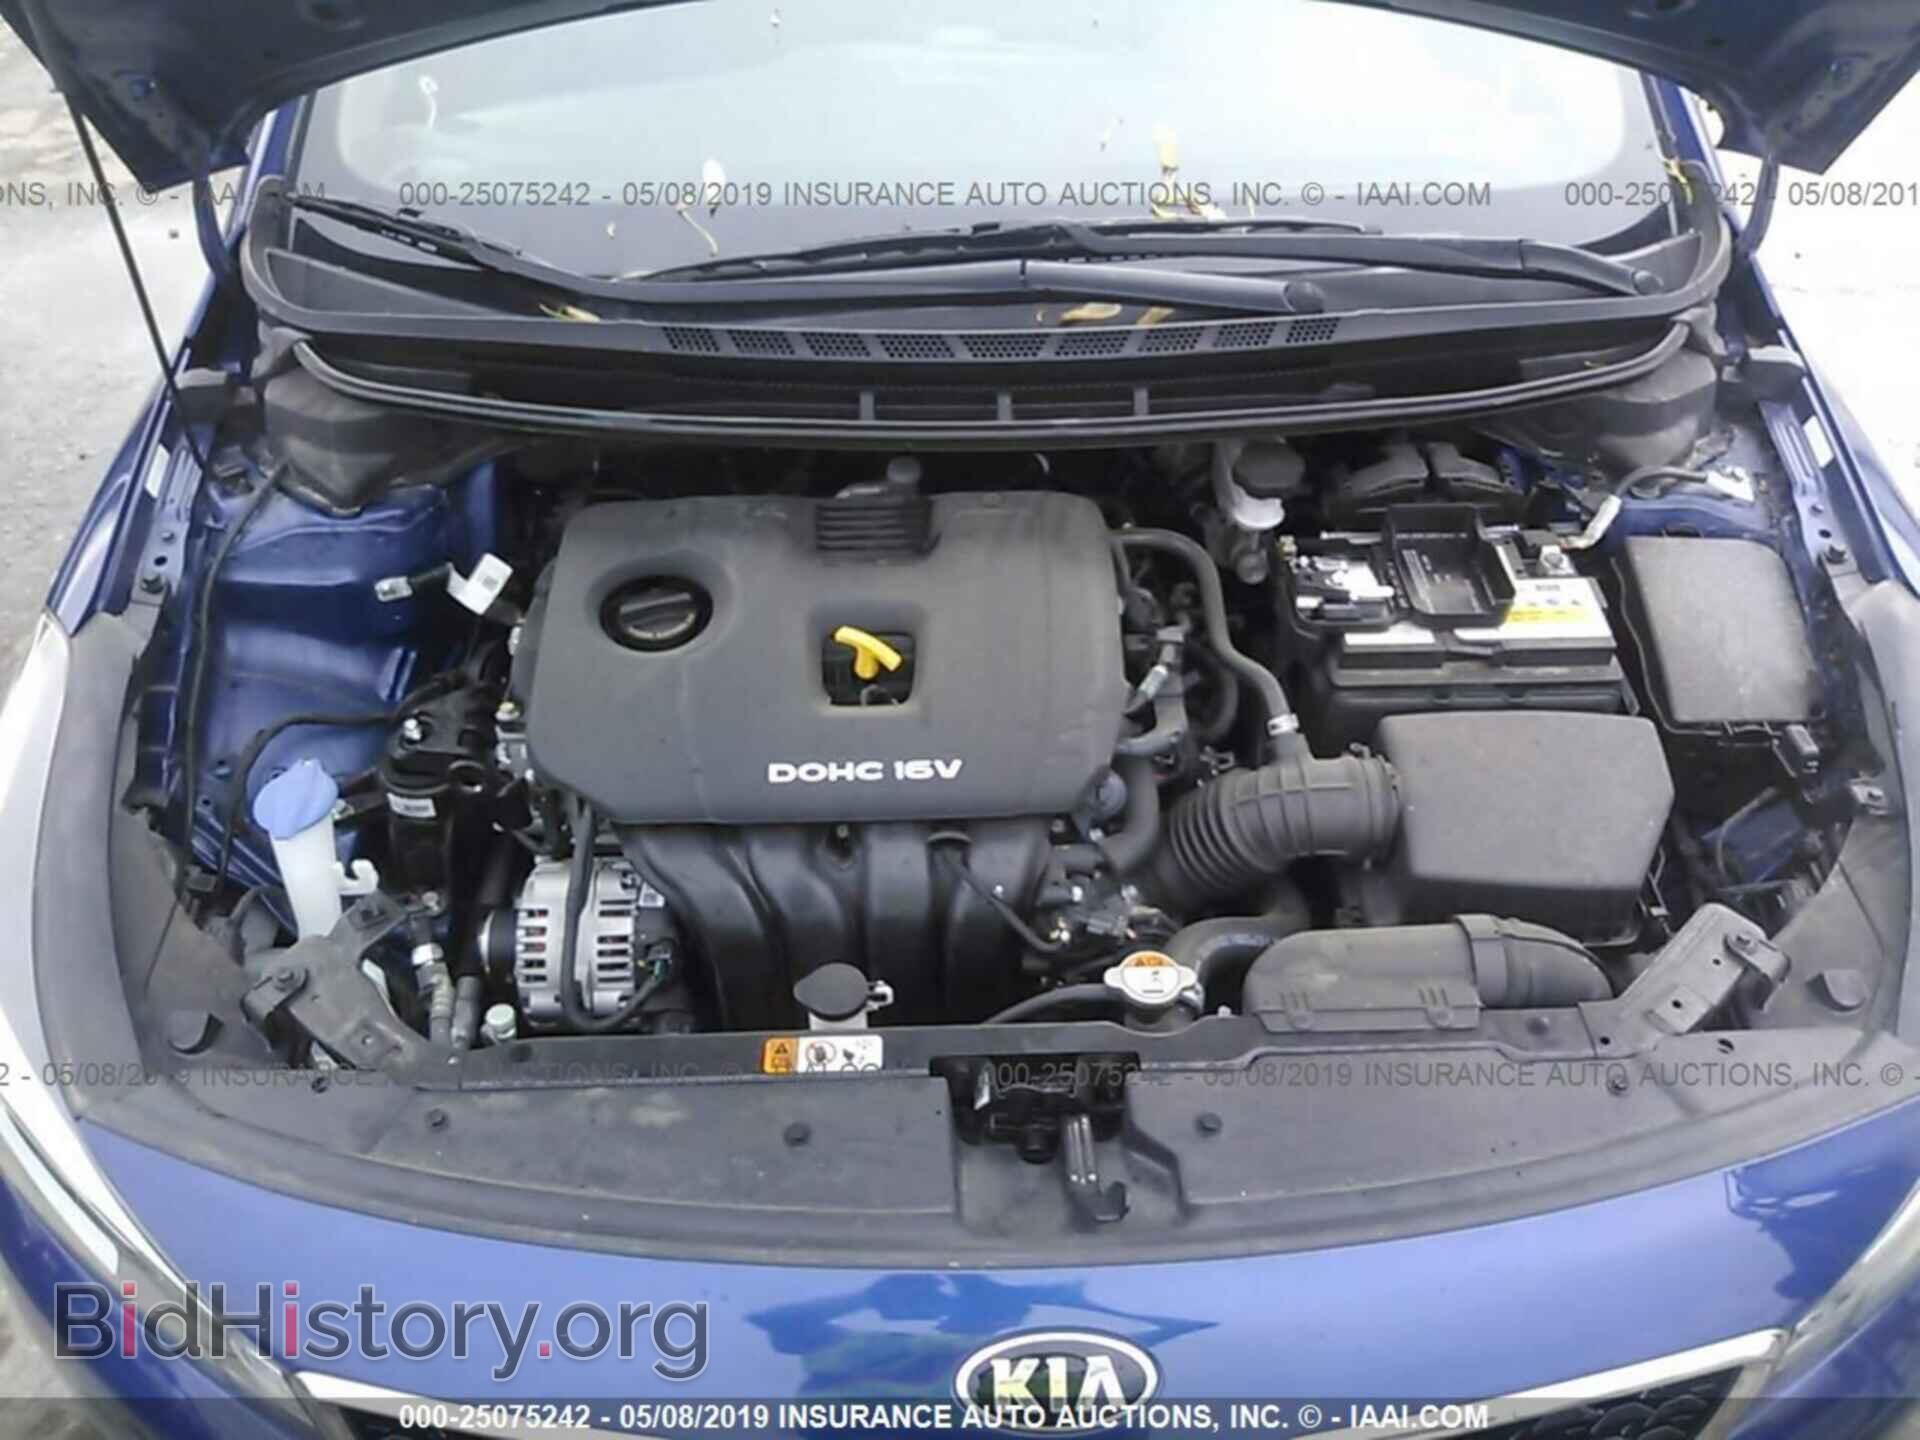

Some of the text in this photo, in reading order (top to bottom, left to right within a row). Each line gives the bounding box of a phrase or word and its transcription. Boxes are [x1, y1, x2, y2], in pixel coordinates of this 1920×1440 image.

[768, 758, 963, 784] DOHC 16V
[990, 1355, 1126, 1412] KIA
